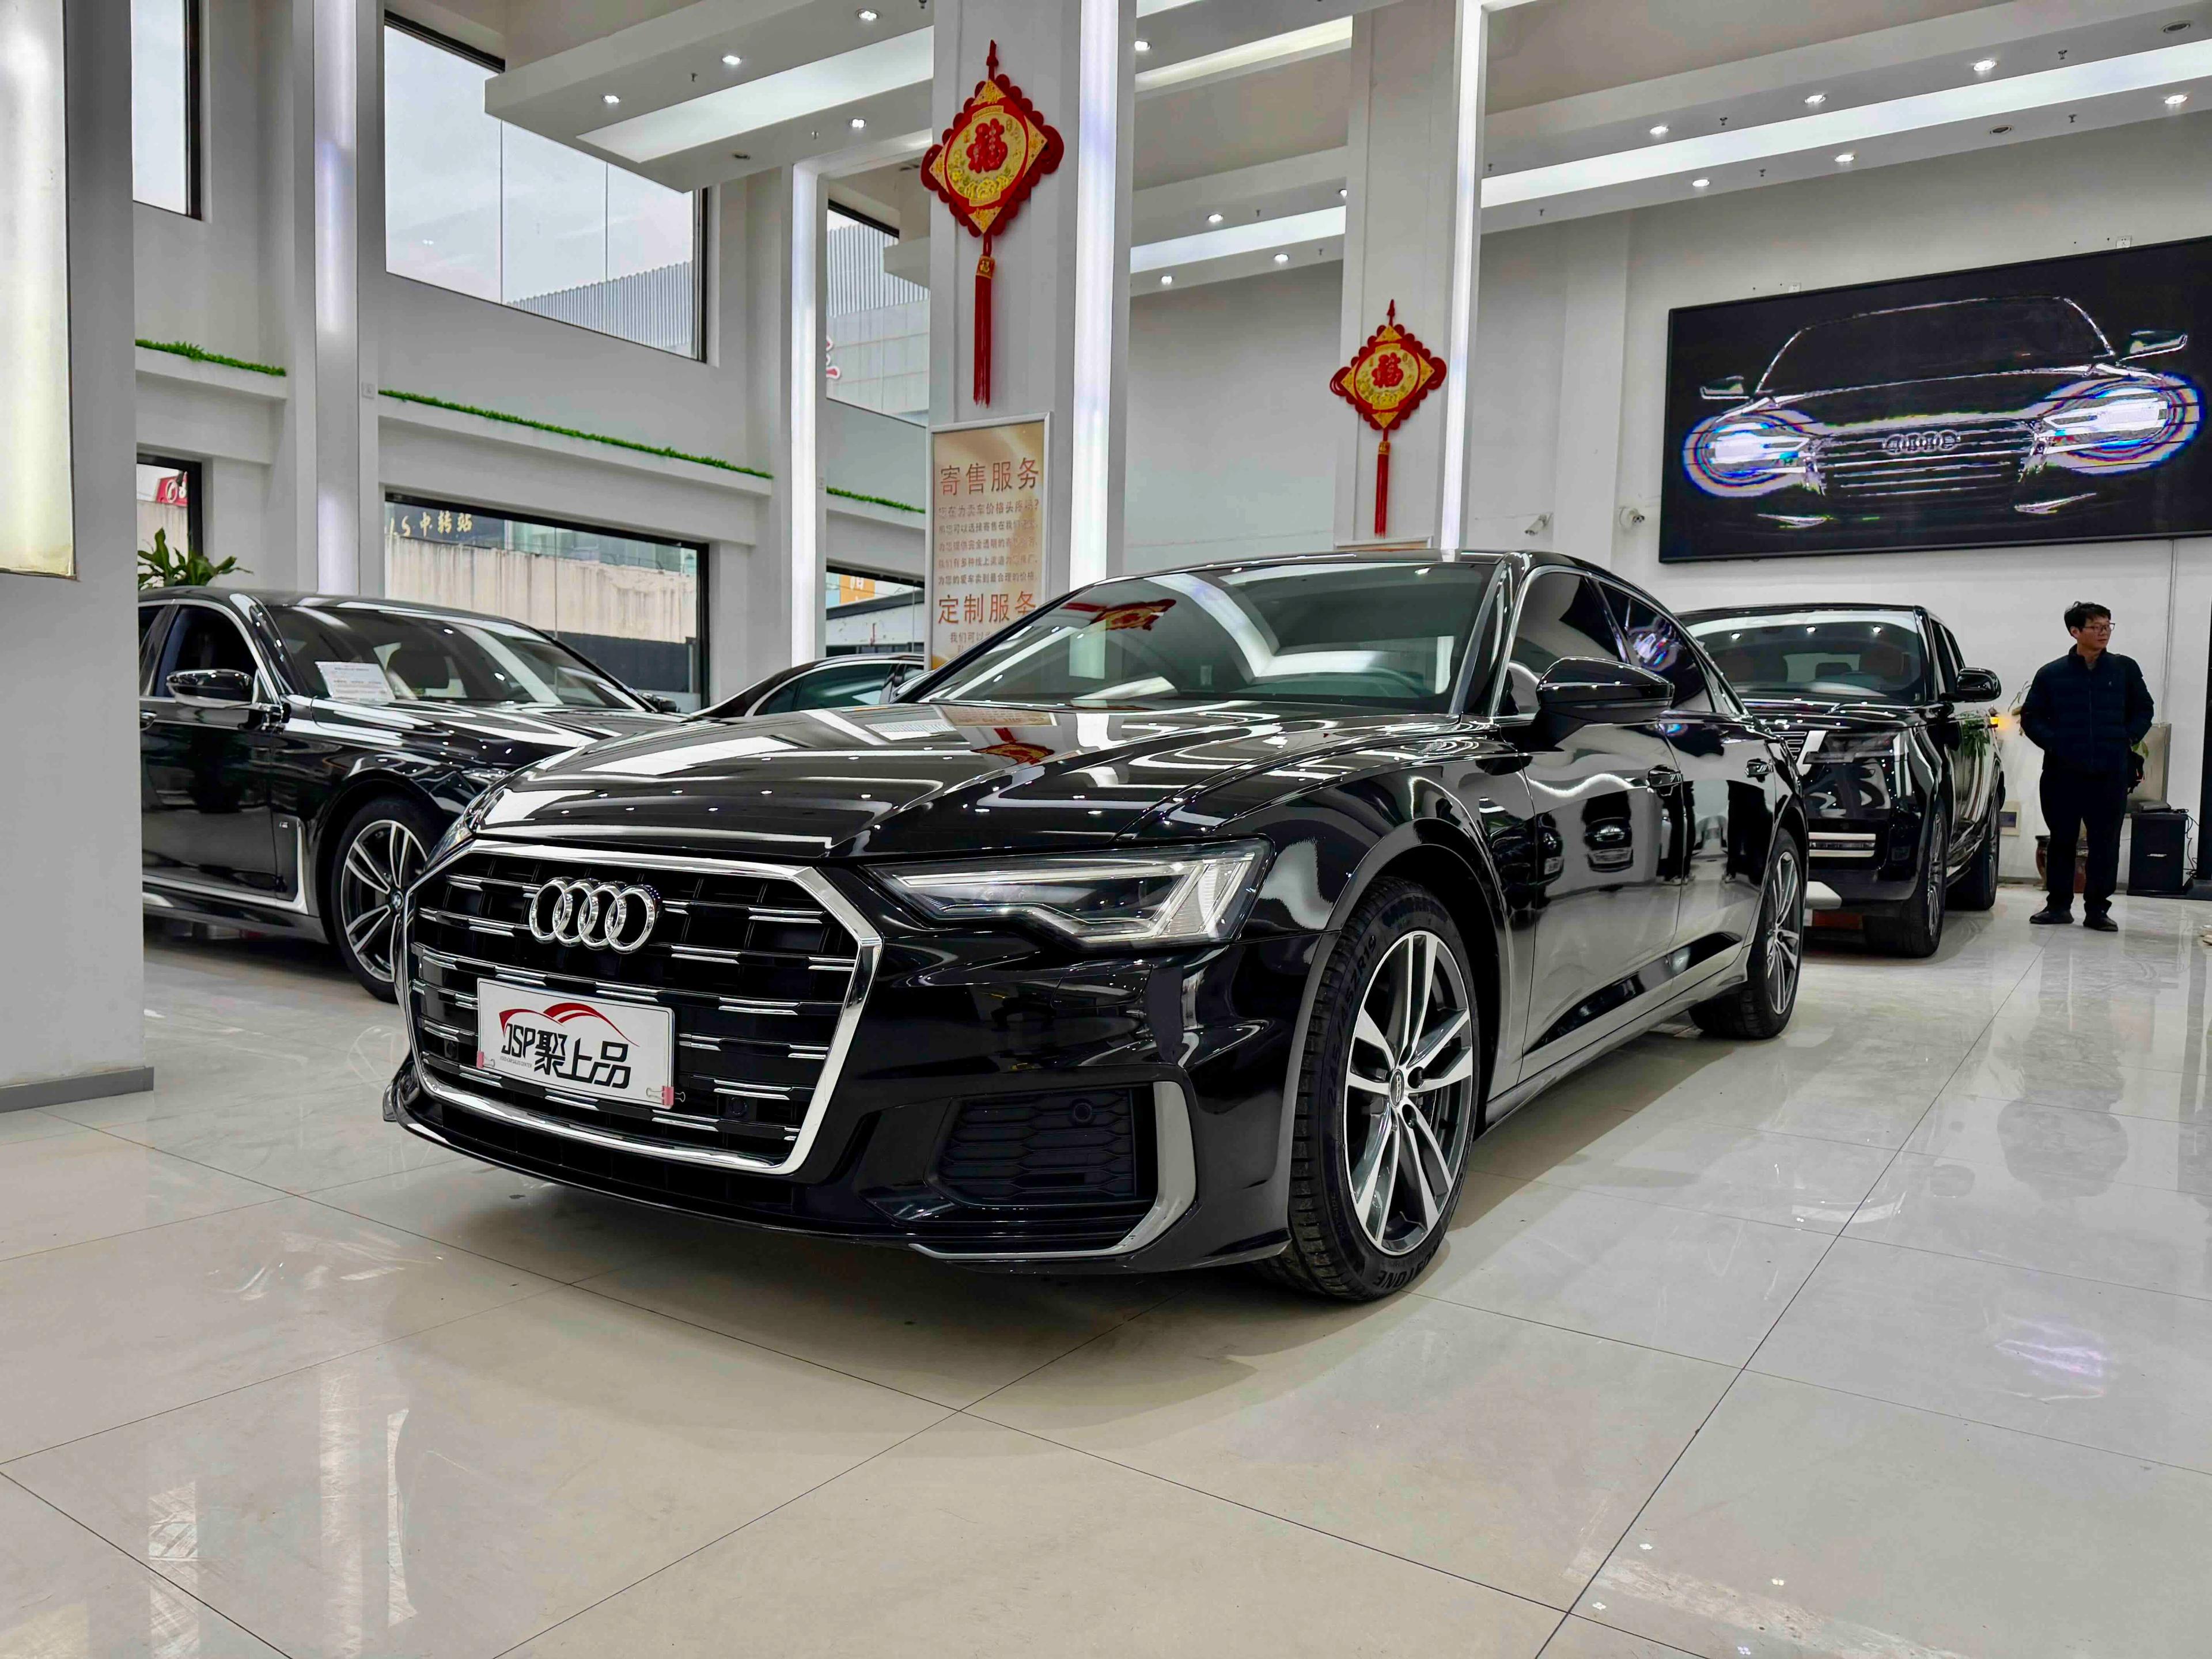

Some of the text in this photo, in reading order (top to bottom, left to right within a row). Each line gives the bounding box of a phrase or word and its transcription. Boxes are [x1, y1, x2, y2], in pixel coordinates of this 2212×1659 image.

[940, 457, 1039, 496] 寄售服务
[938, 591, 1036, 624] 定制服务
